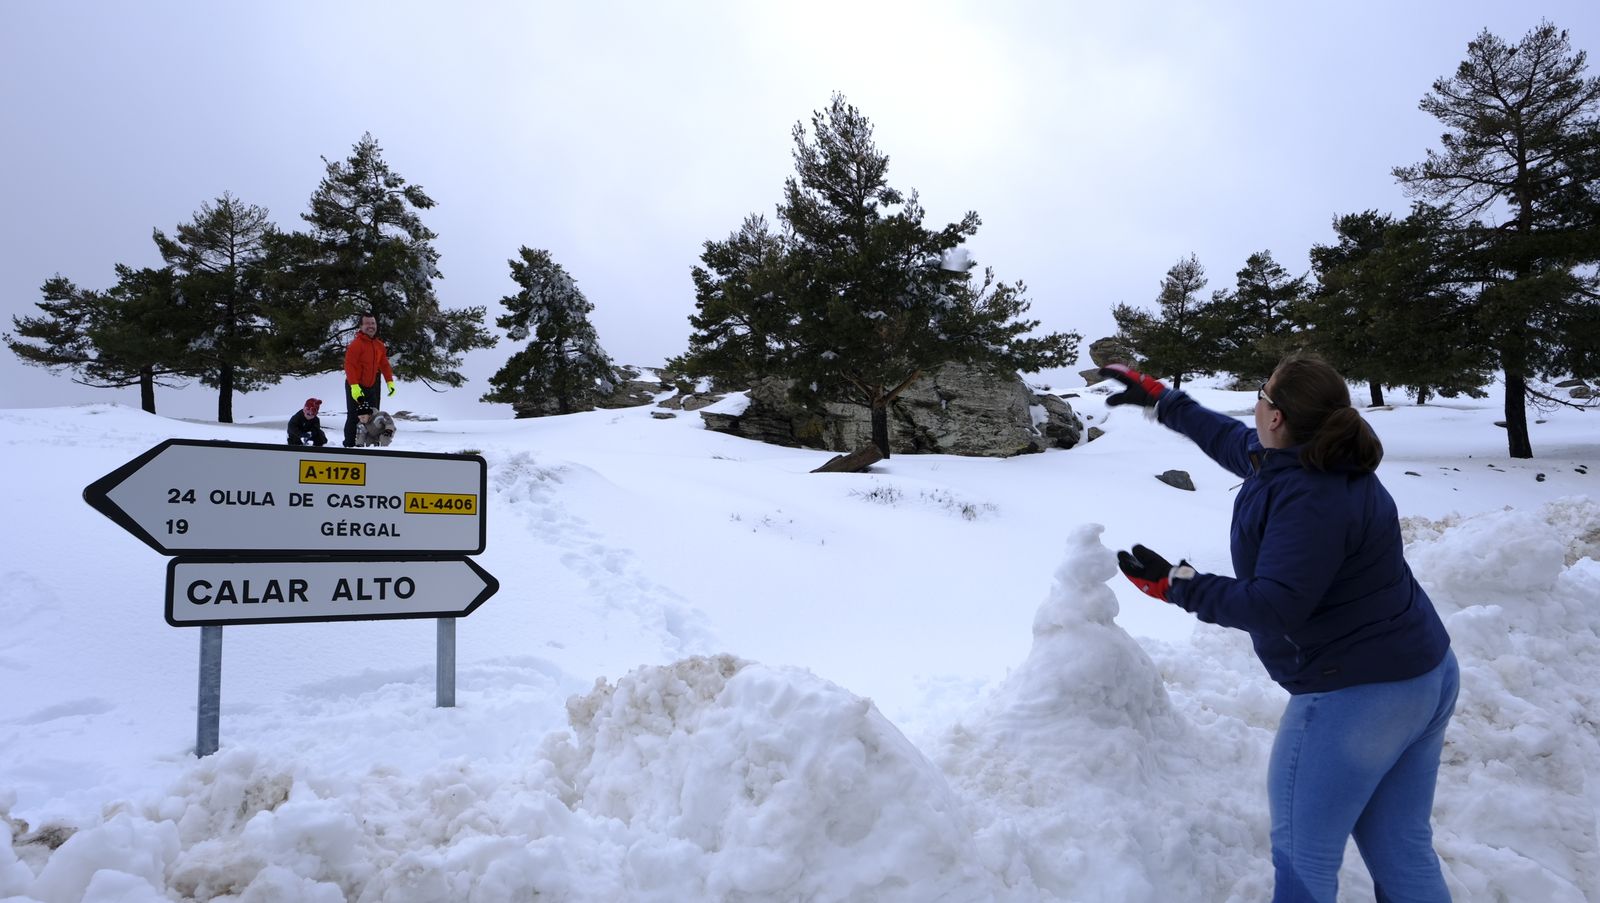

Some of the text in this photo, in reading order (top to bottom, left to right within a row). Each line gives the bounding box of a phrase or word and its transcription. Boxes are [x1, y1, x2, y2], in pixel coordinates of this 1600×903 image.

[304, 465, 361, 481] A-1178
[167, 488, 402, 510] 24 OLULA DE CASTRO
[408, 497, 473, 511] AL-4406
[165, 518, 401, 538] 19 GÉRGAL
[186, 576, 416, 606] CALAR ALTO
